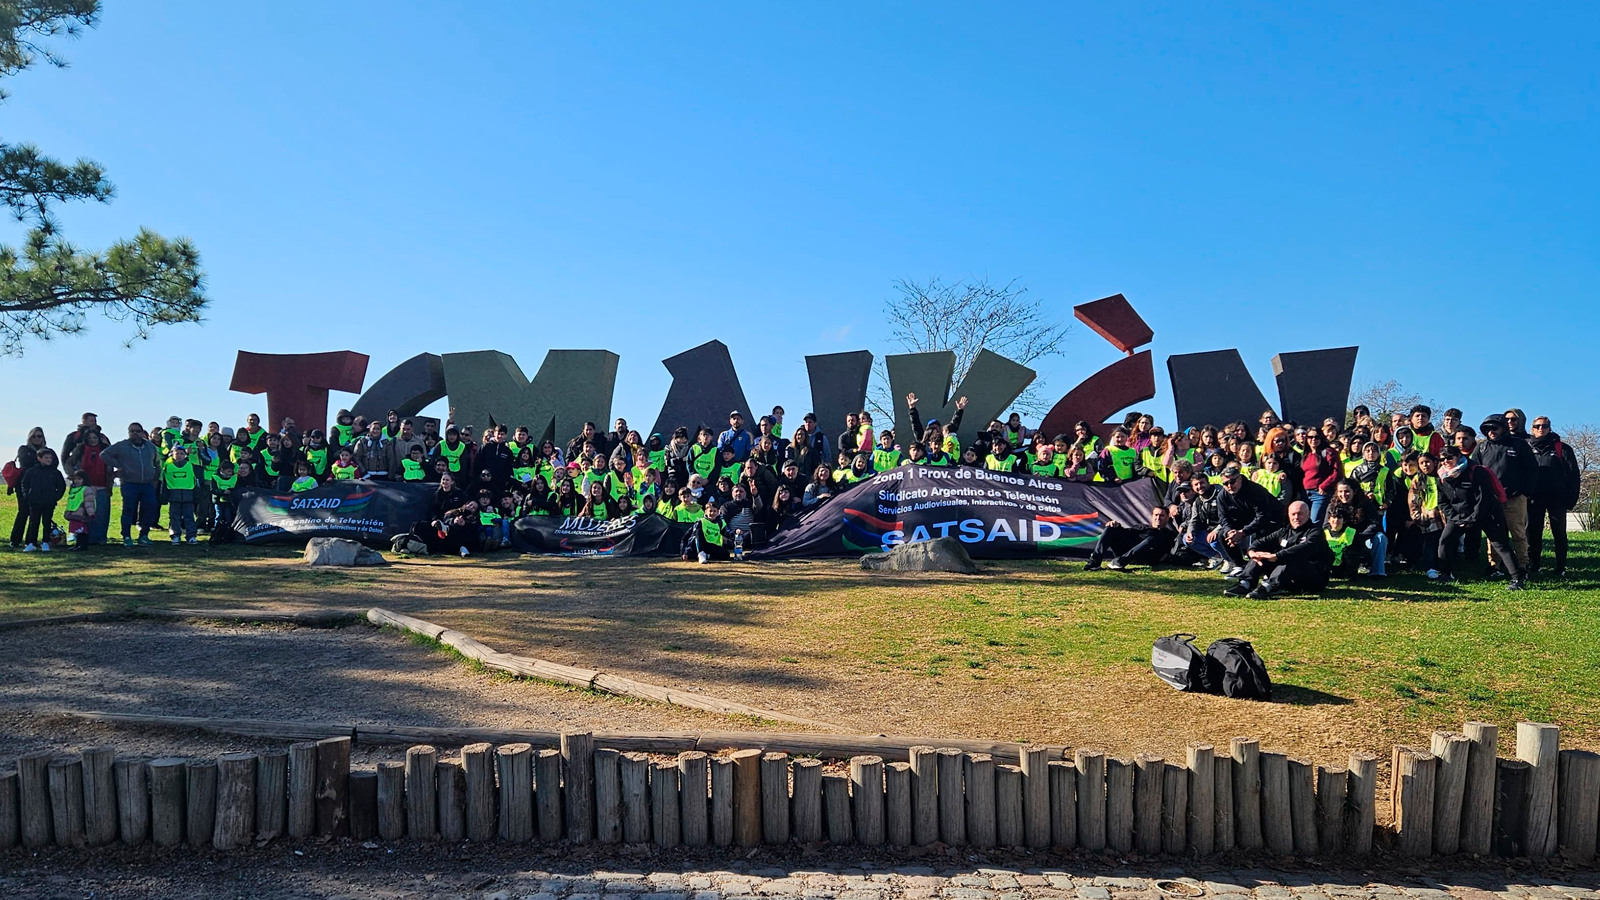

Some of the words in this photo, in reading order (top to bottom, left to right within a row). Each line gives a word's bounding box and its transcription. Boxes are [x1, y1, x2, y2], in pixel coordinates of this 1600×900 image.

[872, 471, 904, 485] Zona
[907, 467, 914, 479] 1
[918, 468, 952, 479] Prov.
[955, 468, 972, 479] de
[975, 469, 1025, 486] Buenos
[1028, 478, 1063, 491] Aires
[290, 498, 341, 509] SATSAID
[878, 488, 929, 502] Sindicato
[930, 486, 985, 498] Argentino
[987, 489, 1001, 497] de
[1002, 490, 1060, 504] Televisión
[878, 504, 913, 515] Servicios
[913, 498, 970, 510] Audiovisuales,
[971, 499, 1018, 508] Interactivos
[1026, 503, 1036, 511] de
[279, 517, 322, 526] Argentino
[339, 517, 384, 527] Televisión
[881, 518, 1062, 553] SATSAID
